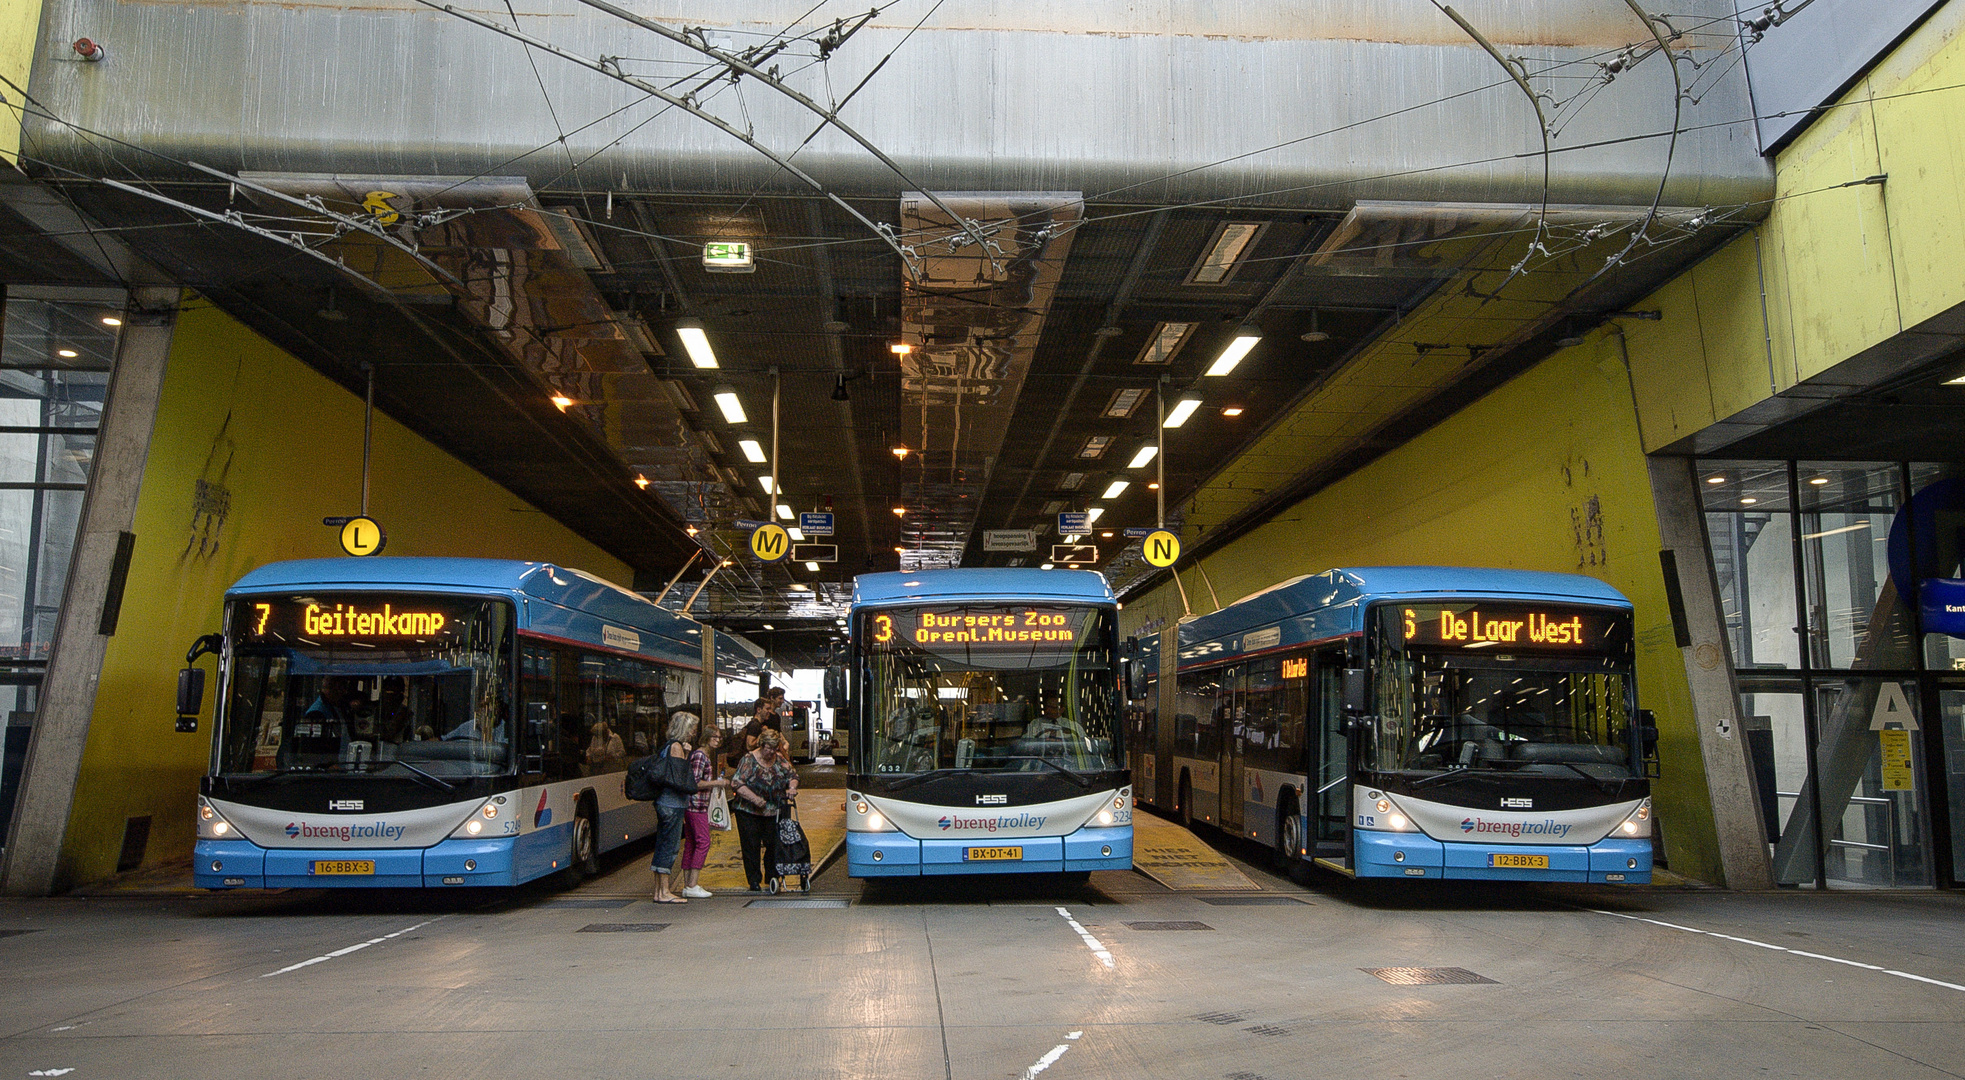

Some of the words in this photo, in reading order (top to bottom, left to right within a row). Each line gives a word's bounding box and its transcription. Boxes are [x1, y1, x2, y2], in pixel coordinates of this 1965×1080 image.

[354, 527, 368, 549] L
[756, 530, 783, 554] M
[1153, 538, 1172, 560] N
[255, 603, 271, 635] 7
[305, 603, 445, 635] Geitenkamp
[875, 614, 893, 642] 3
[922, 612, 1015, 628] Burgers
[1024, 611, 1066, 627] Zoo
[1441, 610, 1468, 641] De
[1472, 611, 1524, 642] Laar
[1529, 613, 1583, 645] West
[915, 628, 1074, 643] Openl.Museum
[1868, 681, 1920, 731] A
[329, 799, 364, 811] HESS
[975, 794, 1008, 805] HESS
[1500, 797, 1533, 808] HESS
[952, 813, 1047, 832] brengtrolley
[1112, 810, 1132, 824] 5234
[301, 821, 406, 842] brengtrolley
[1476, 817, 1573, 839] brengtrolley
[972, 848, 1018, 860] BX-DT-41
[1498, 855, 1544, 867] 12-BBX-3
[319, 861, 370, 873] 16-BBX-3
